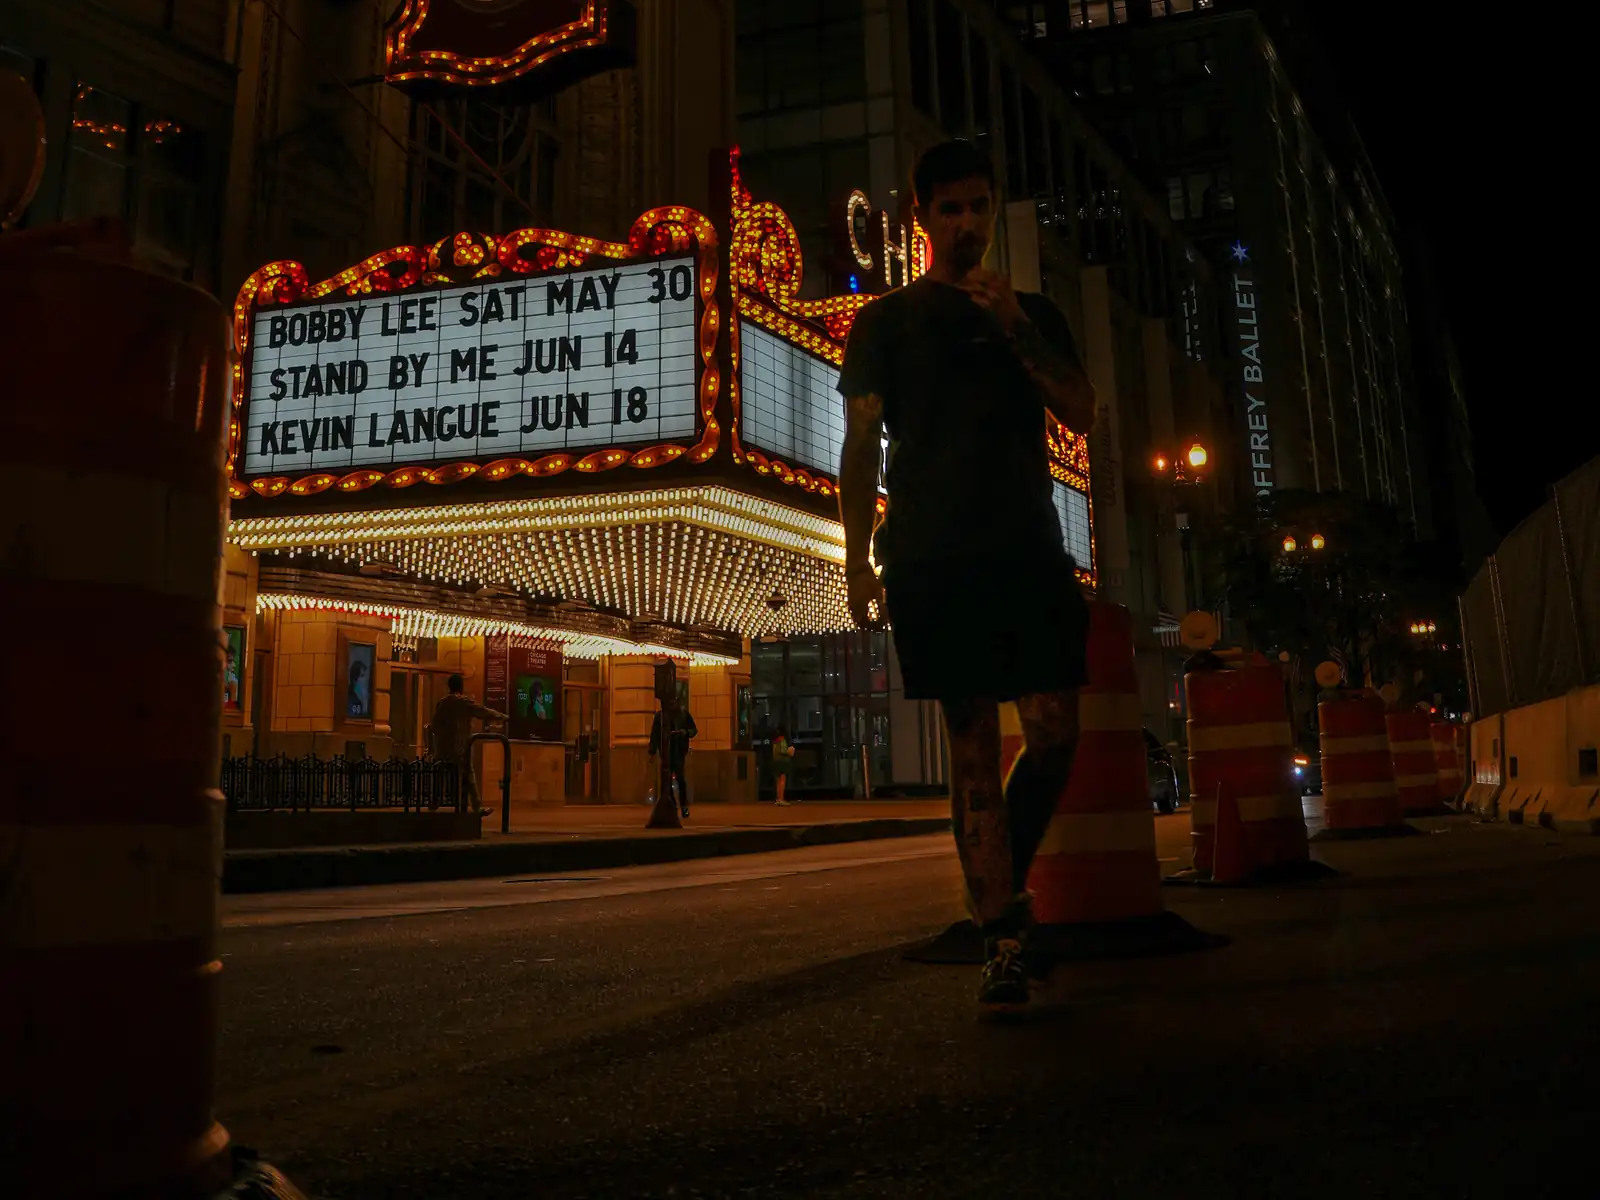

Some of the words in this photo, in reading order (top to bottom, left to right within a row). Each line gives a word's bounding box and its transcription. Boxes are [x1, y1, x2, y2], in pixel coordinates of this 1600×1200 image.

[269, 305, 367, 349] BOBBY
[381, 296, 438, 336] LEE
[459, 286, 526, 327] SAT
[545, 272, 622, 317] MAY
[646, 264, 693, 302] 30
[1231, 273, 1265, 383] BALLET
[268, 359, 369, 402] STAND
[388, 351, 431, 391] BY
[450, 344, 499, 384] ME
[513, 335, 582, 376] JUN
[604, 328, 640, 368] 14
[259, 414, 354, 457] KEVIN
[368, 400, 501, 448] LANGUE
[519, 391, 589, 434] JUN
[611, 386, 649, 426] 18
